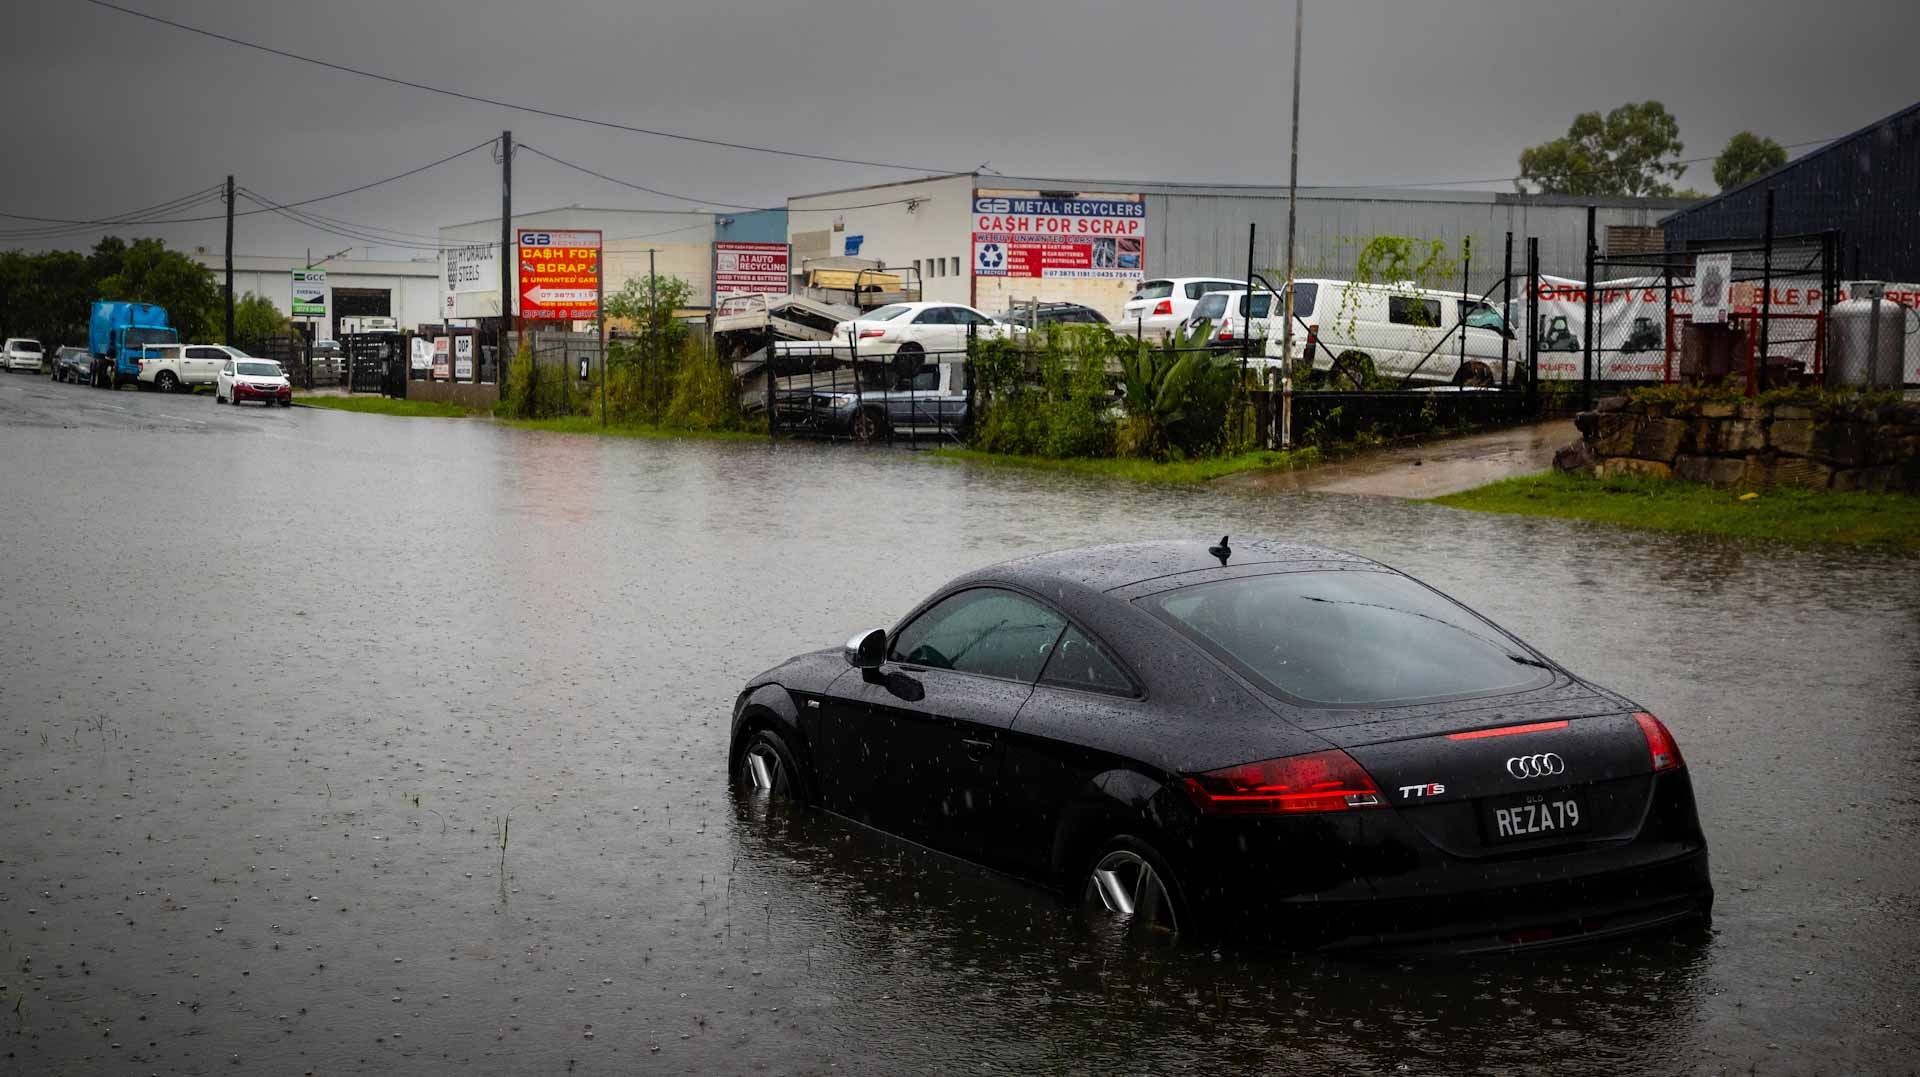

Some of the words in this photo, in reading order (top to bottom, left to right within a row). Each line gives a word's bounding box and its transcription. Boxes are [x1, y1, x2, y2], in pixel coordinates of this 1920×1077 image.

[976, 199, 1010, 213] GB
[1014, 201, 1059, 214] METAL
[1063, 203, 1143, 216] RECYCLERS
[979, 215, 1029, 232] CA$H
[1036, 216, 1071, 233] FOR
[1078, 218, 1139, 234] SCRAP
[522, 233, 550, 246] GB
[993, 234, 1011, 242] BUY
[1014, 235, 1065, 243] UNWANTED
[460, 243, 493, 261] HYDRAULIC
[522, 248, 564, 260] CA$H
[569, 249, 597, 259] FOR
[459, 265, 480, 282] STEELS
[536, 263, 587, 273] SCRAP
[740, 263, 786, 271] RECYCLING
[306, 273, 325, 281] GCC
[1526, 280, 1632, 303] ORKLIFT
[1643, 286, 1658, 303] &
[570, 309, 597, 319] DAY
[1496, 800, 1579, 836] REZA79
